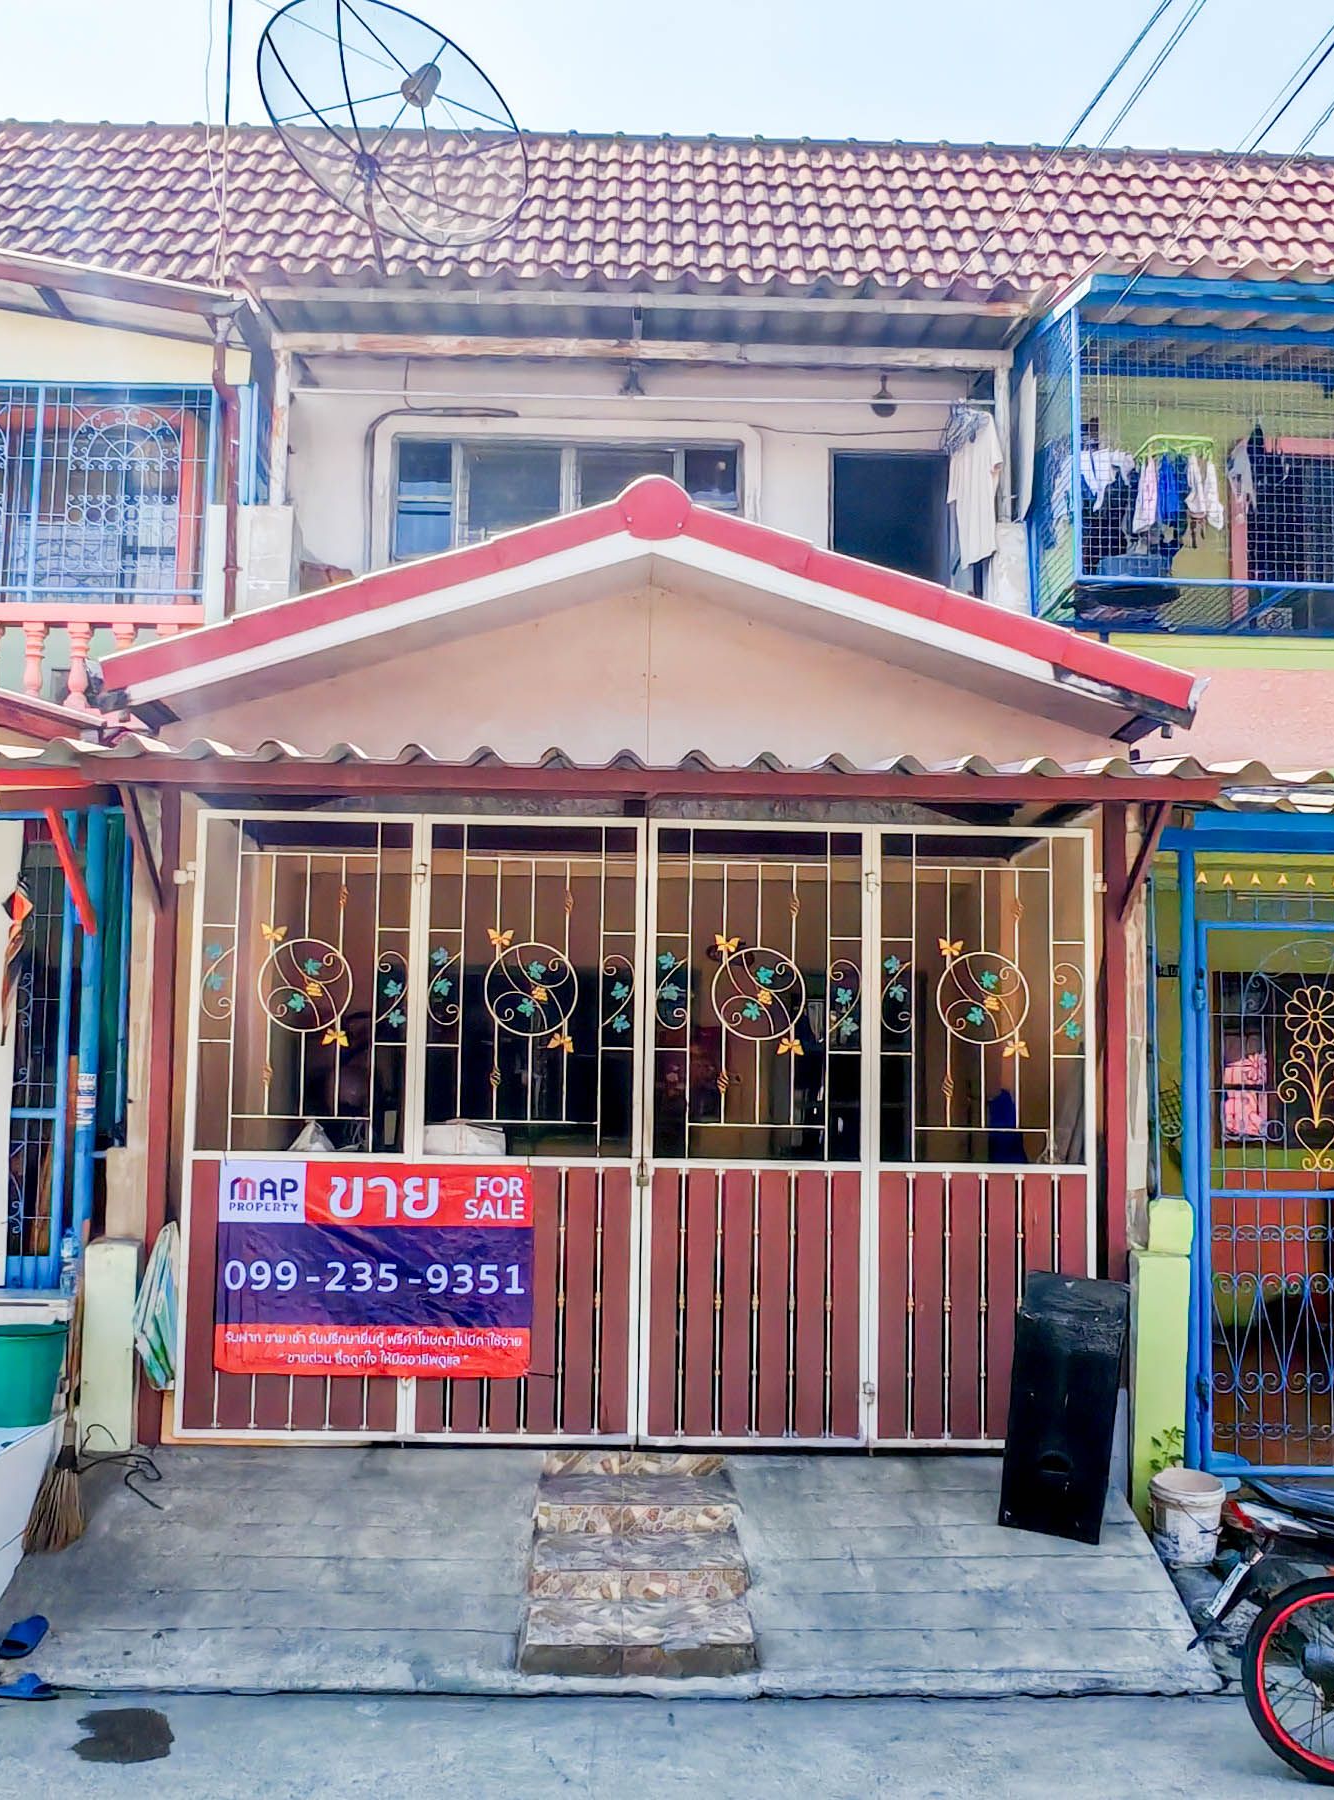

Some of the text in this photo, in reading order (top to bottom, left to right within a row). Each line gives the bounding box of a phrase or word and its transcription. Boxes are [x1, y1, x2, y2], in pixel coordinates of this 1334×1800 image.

[230, 1178, 299, 1201] MAP
[329, 1175, 440, 1219] ขาย
[475, 1176, 524, 1198] FOR
[229, 1202, 299, 1212] PROPERTY
[464, 1200, 525, 1220] SALE
